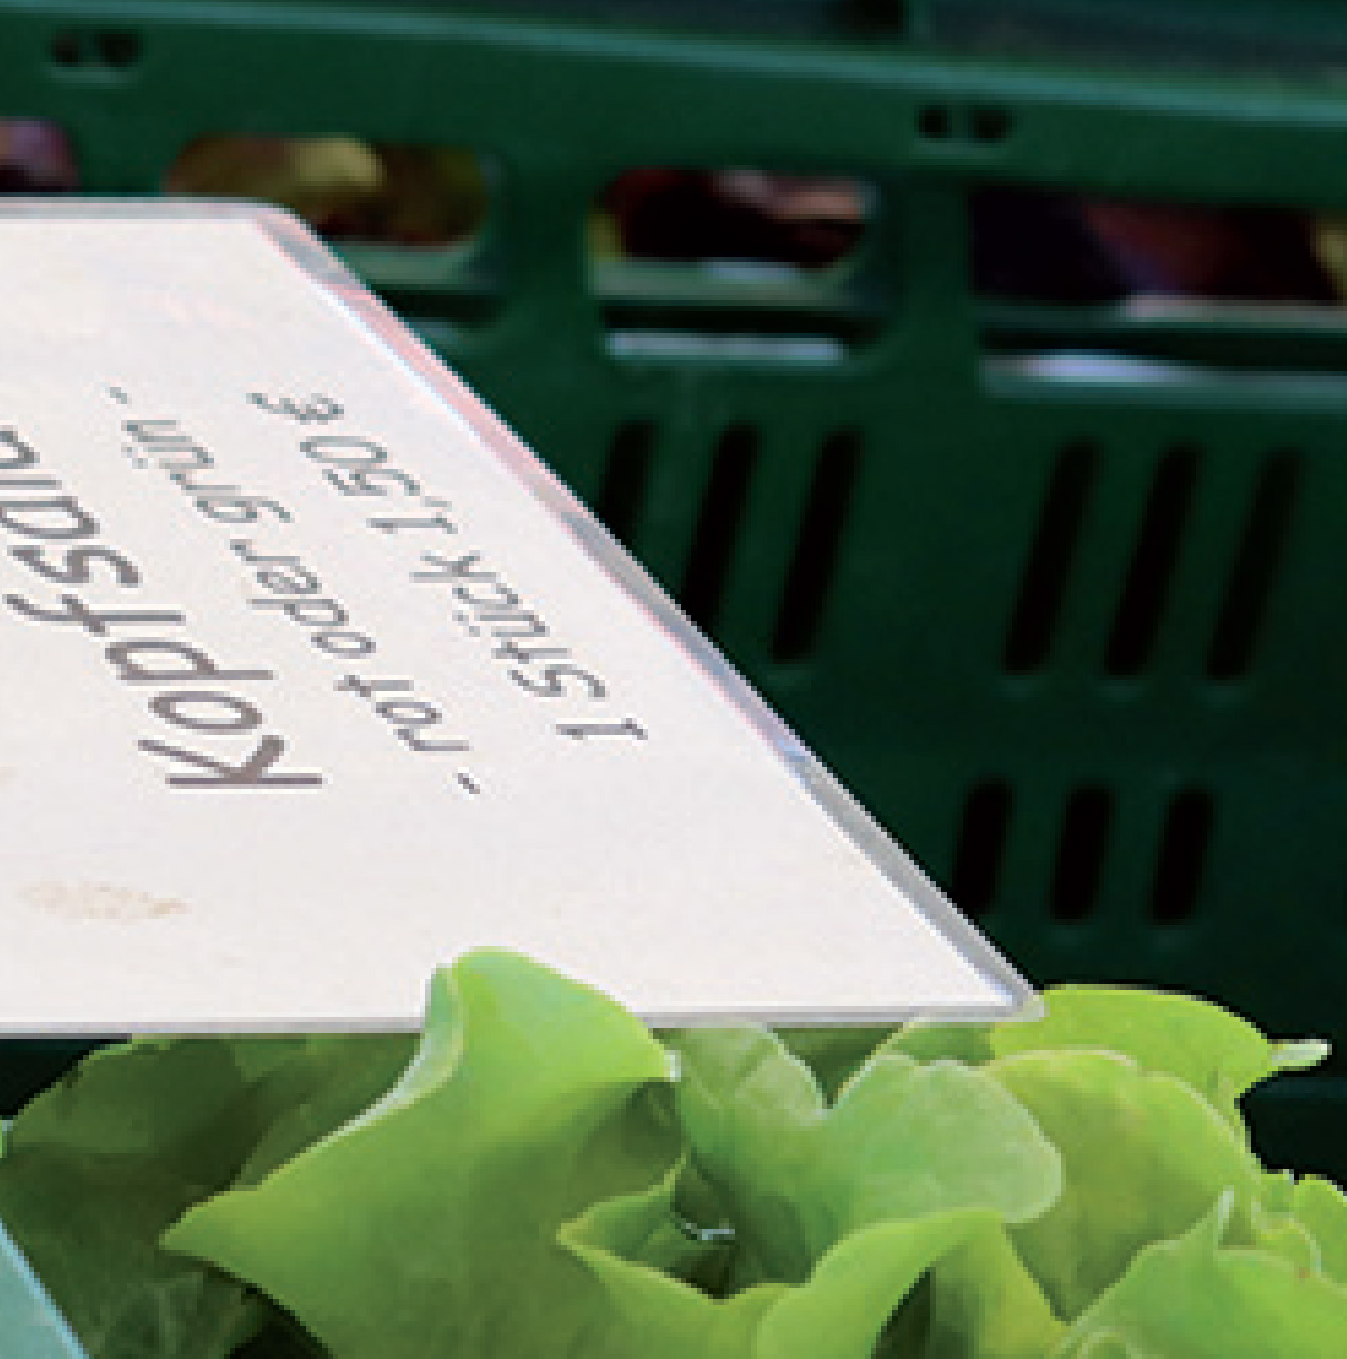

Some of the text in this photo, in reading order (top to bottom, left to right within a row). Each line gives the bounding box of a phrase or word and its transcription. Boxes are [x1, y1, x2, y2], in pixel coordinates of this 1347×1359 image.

[119, 418, 292, 524] grün
[299, 435, 460, 535] 1,50
[229, 538, 377, 660] oder
[409, 554, 607, 698] Stück
[331, 673, 470, 752] rot
[555, 717, 649, 741] 1
